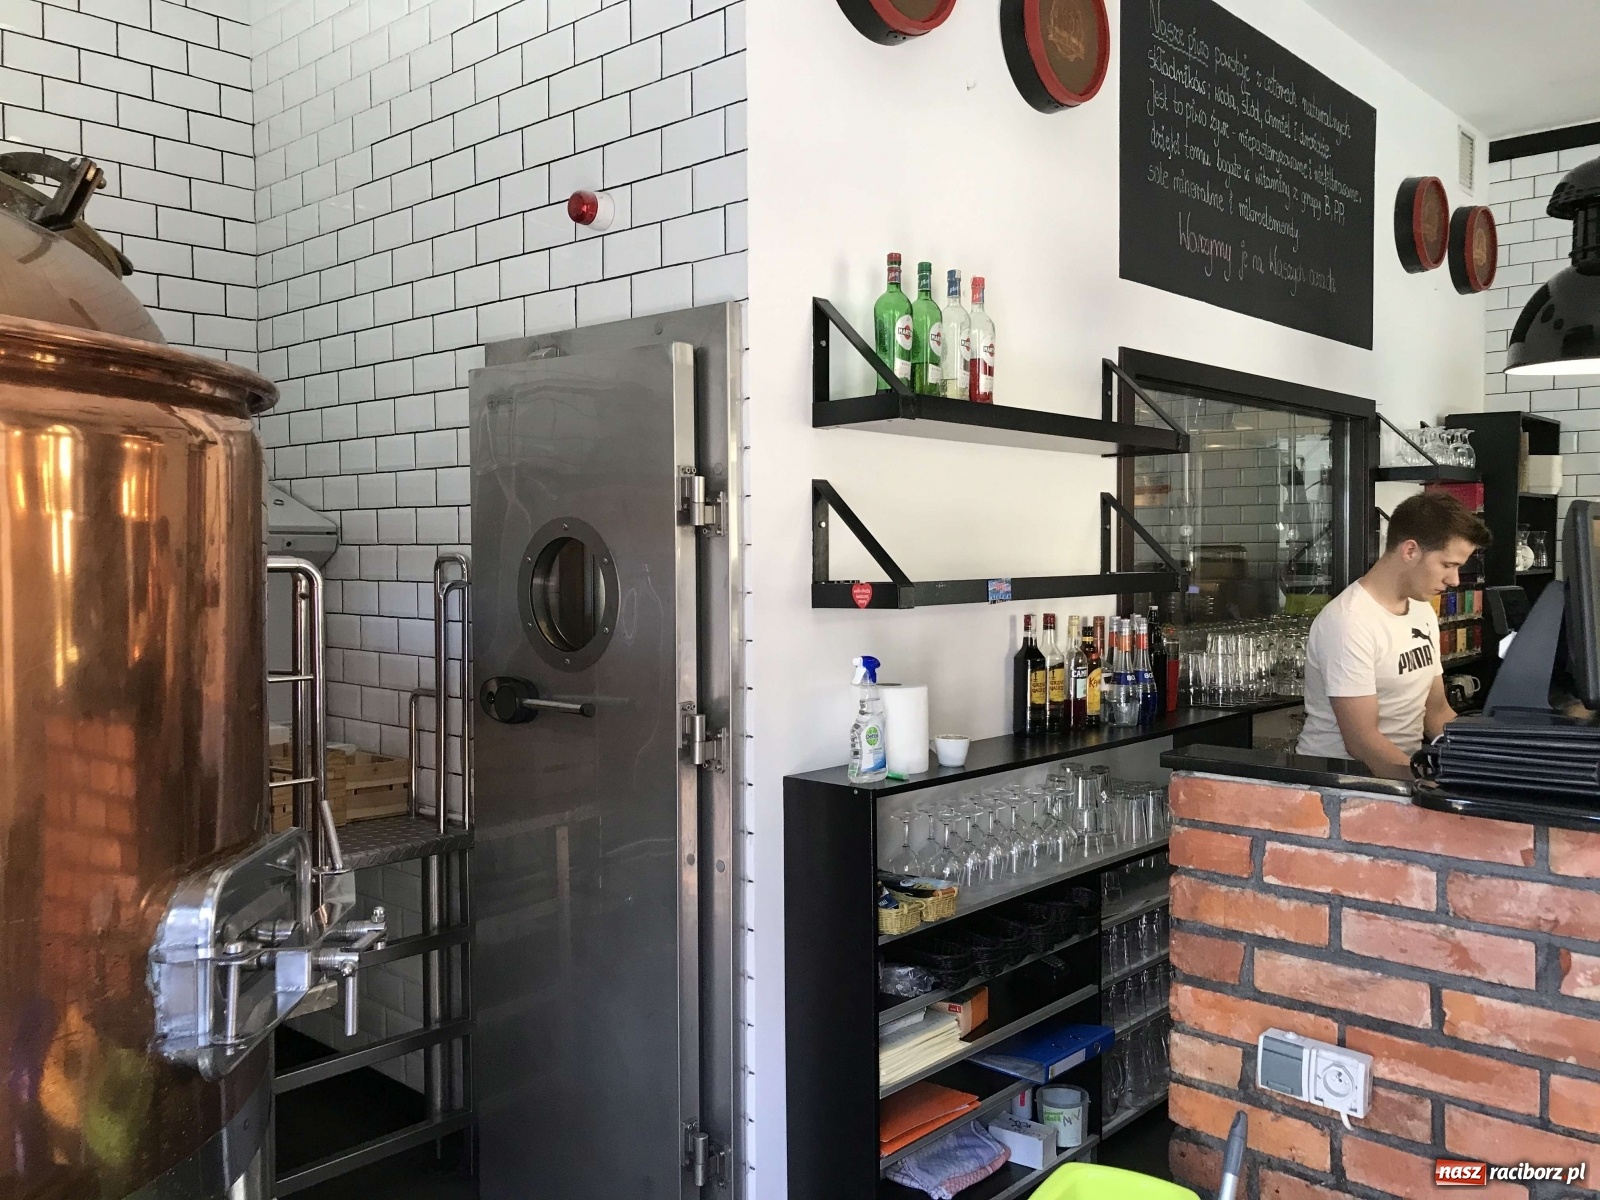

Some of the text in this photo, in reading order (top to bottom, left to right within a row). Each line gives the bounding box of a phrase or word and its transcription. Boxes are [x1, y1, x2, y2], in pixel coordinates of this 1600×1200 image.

[1150, 0, 1185, 46] Nasze
[1188, 27, 1209, 60] piwo
[1147, 77, 1169, 116] Jest
[1173, 87, 1184, 116] to
[1185, 99, 1207, 128] piwo
[1147, 161, 1169, 190] sole
[1173, 168, 1224, 213] mineralne
[1228, 189, 1234, 216] i
[1184, 131, 1212, 167] temu
[1292, 186, 1299, 201] z
[1301, 191, 1322, 221] grupy
[1178, 211, 1232, 282] Warzymy
[1238, 240, 1248, 281] je
[1252, 254, 1265, 275] na
[1398, 644, 1433, 675] PUMA
